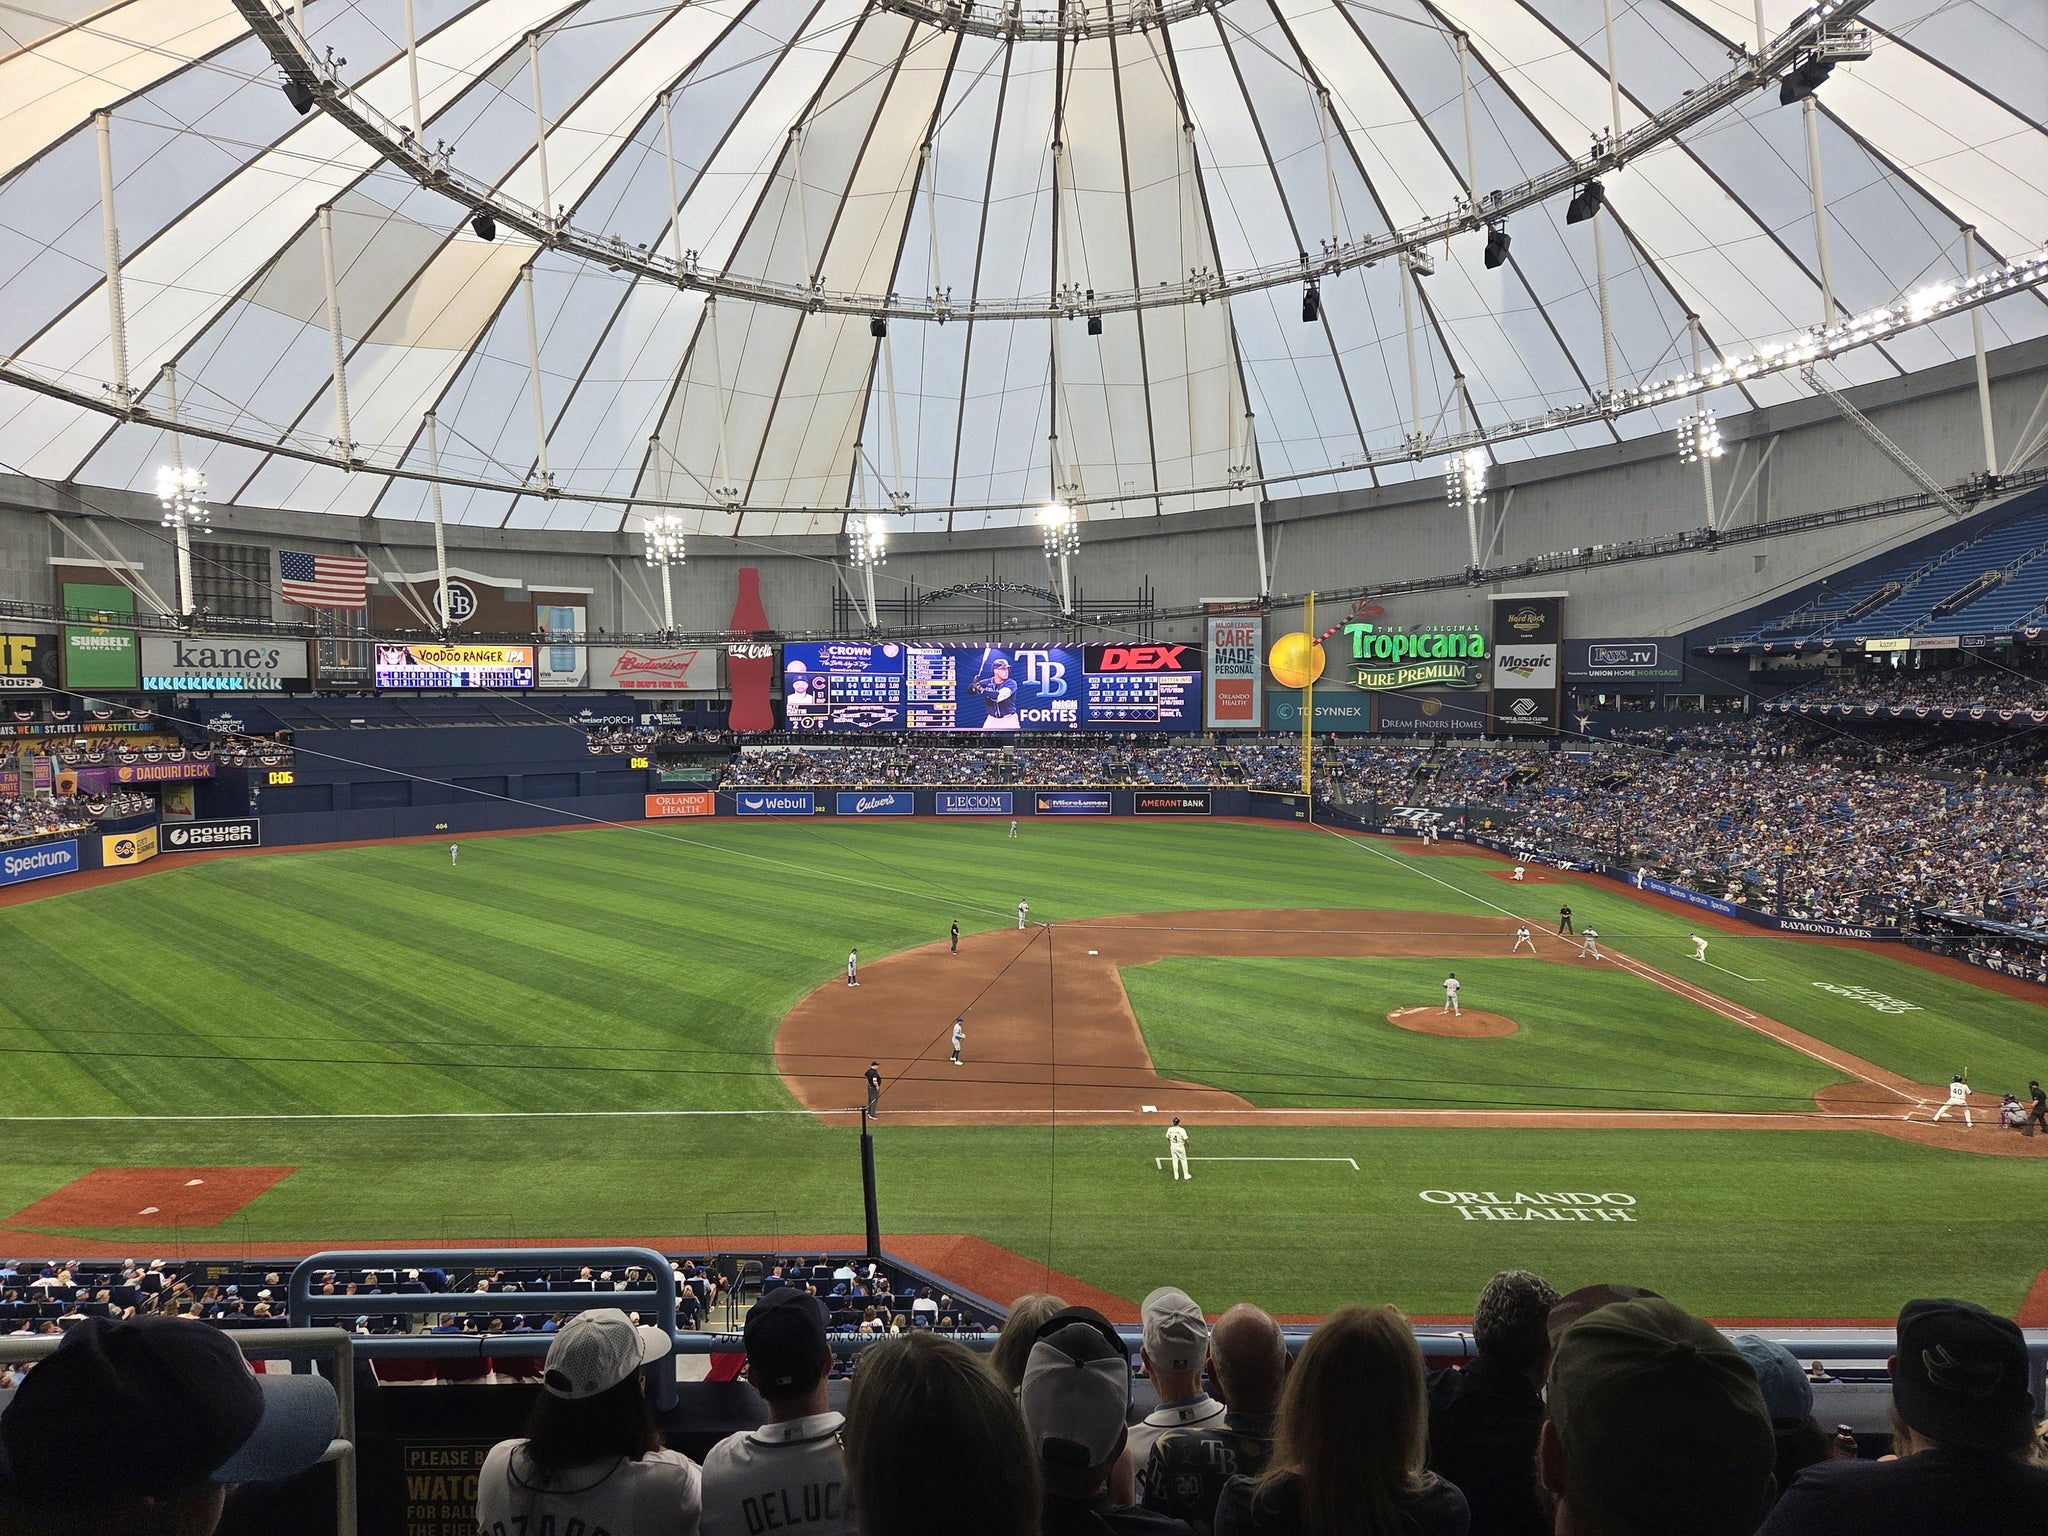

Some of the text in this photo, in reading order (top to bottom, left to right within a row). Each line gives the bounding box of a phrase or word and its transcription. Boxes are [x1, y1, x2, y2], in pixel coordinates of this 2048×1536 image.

[1508, 614, 1545, 623] Hard Rock
[71, 636, 129, 646] SUNBELT
[1215, 630, 1254, 647] CARE
[1343, 623, 1485, 662] Tropicana
[172, 640, 280, 669] kane's
[419, 650, 525, 663] VOODOO RANGER IPA
[829, 646, 872, 655] CROWN
[1215, 648, 1254, 664] MADE
[1630, 652, 1650, 662] .TV
[618, 657, 688, 670] Budweiser
[1100, 646, 1186, 670] DEX
[1499, 654, 1551, 667] Mosaic
[514, 668, 531, 679] 0-0
[1014, 650, 1068, 698] TB
[1215, 665, 1254, 674] PERSONAL
[1358, 665, 1465, 686] PURE PREMIUM
[1020, 709, 1077, 722] FORTES
[1315, 707, 1361, 716] SYNNEX
[603, 716, 634, 724] PORCH
[1381, 719, 1483, 728] DREAM FINDERS HOMES
[18, 726, 29, 734] WE
[58, 725, 76, 733] PETE
[207, 724, 244, 732] PORCH
[136, 764, 210, 781] DAIQUIRI DECK
[656, 796, 705, 806] ORLANDO
[766, 797, 806, 809] Webull
[856, 794, 895, 813] Culver's
[662, 806, 700, 814] HEALTH
[5, 850, 68, 876] Spectrum
[1780, 920, 1872, 938] RAYMOND JAMES
[1953, 1088, 1963, 1096] 40
[1172, 1135, 1178, 1143] 4
[1419, 1190, 1637, 1206] ORLANDO
[1453, 1206, 1638, 1222] HEALTH
[411, 1451, 469, 1466] PLEASE
[1200, 1439, 1239, 1475] TB
[406, 1476, 479, 1501] WATC
[407, 1505, 436, 1520] FOR
[741, 1481, 844, 1536] DELUC
[407, 1523, 436, 1536] THE
